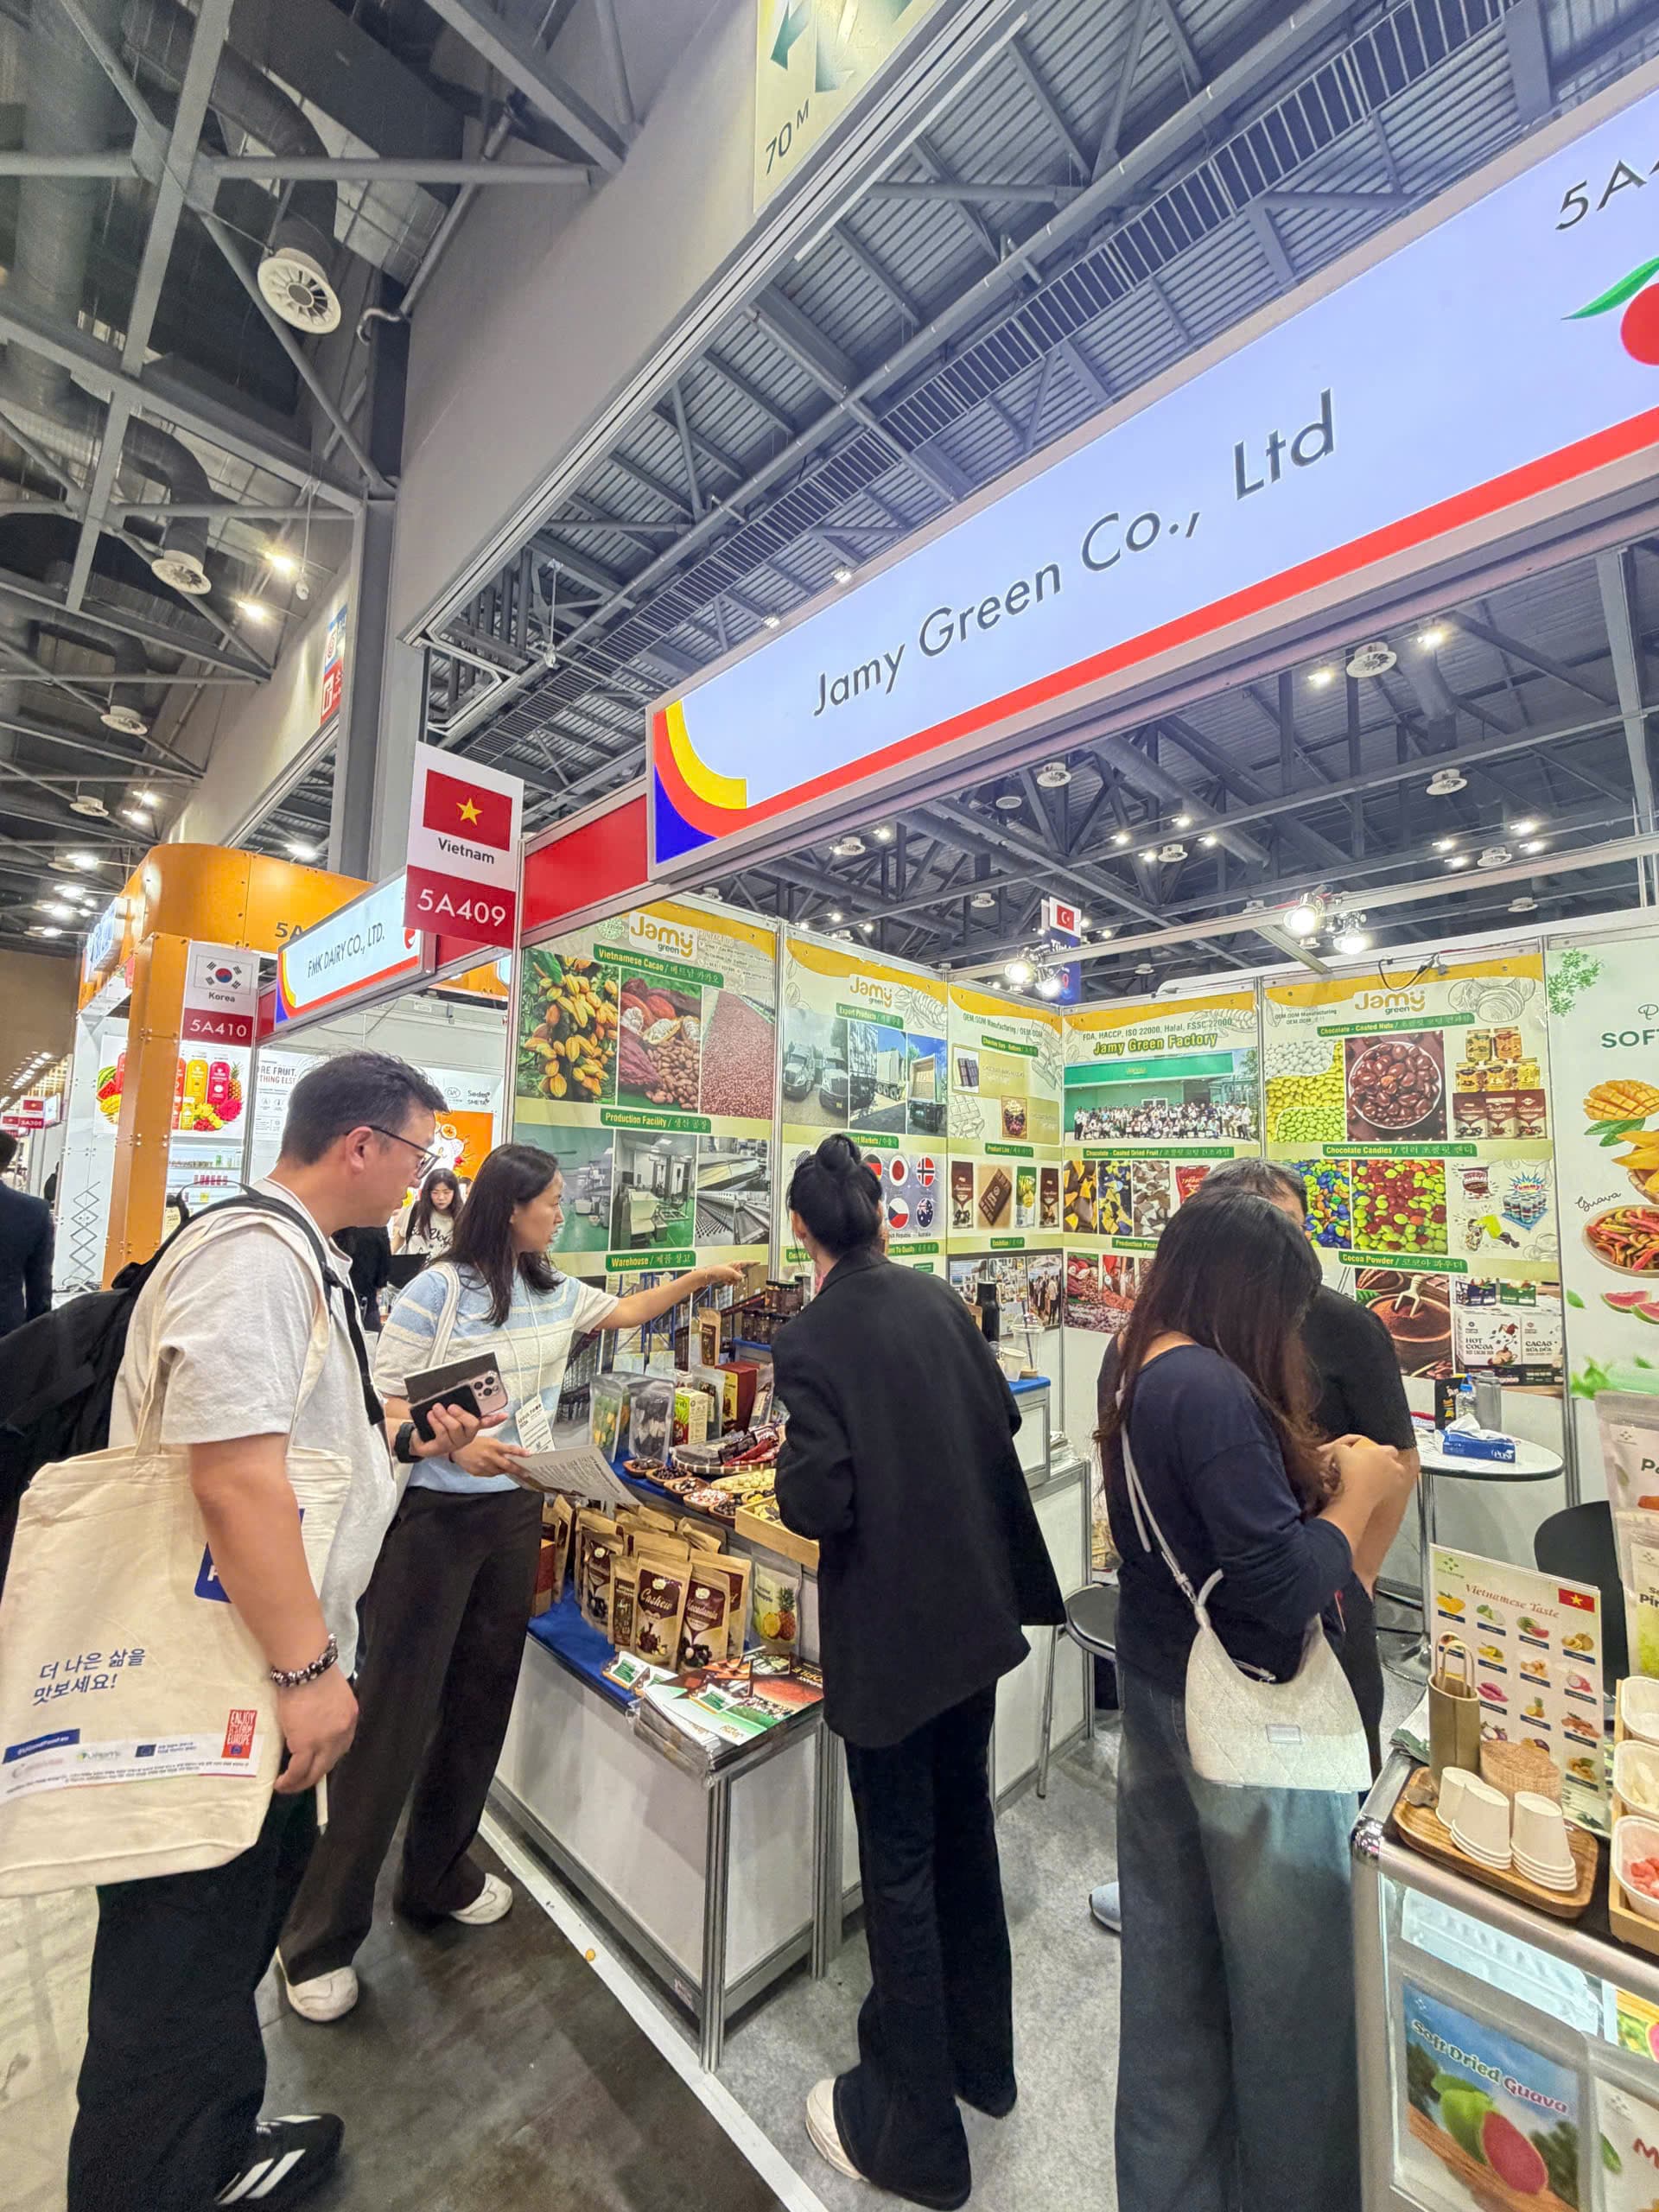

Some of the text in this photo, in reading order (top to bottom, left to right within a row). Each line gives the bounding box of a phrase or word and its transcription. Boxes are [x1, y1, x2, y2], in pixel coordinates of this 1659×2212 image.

[766, 122, 792, 175] 70
[1555, 160, 1659, 231] 5A
[813, 387, 1335, 717] Jamy Green Co., Ltd
[437, 836, 495, 865] Vietnam
[416, 888, 506, 927] 5A409
[324, 941, 346, 970] DAIRY
[367, 923, 385, 948] LTD.
[630, 916, 693, 957] Jamy
[658, 943, 680, 955] green
[599, 949, 642, 967] Vietnamese
[644, 958, 664, 972] Cacao
[208, 991, 236, 1003] Korea
[850, 976, 893, 1008] Jamy
[1354, 990, 1426, 1013] Jamy
[1300, 1008, 1338, 1018] Manufacturing
[1385, 1006, 1410, 1015] green
[189, 1019, 247, 1038] 5A410
[987, 1019, 1016, 1035] Manufacturing
[1125, 1028, 1137, 1038] ISO
[1186, 1021, 1206, 1032] FSSC
[1209, 1017, 1233, 1027] 22000
[1320, 1026, 1350, 1035] Chocolate
[1355, 1023, 1378, 1032] Coated
[1093, 1033, 1217, 1056] Jamy Green Factory
[273, 1066, 297, 1077] FRUIT.
[606, 1112, 641, 1125] Production
[642, 1116, 667, 1128] Facility
[1326, 1146, 1362, 1154] Chocolate
[1363, 1146, 1393, 1154] Candies
[1574, 1191, 1622, 1212] Guava
[612, 1255, 649, 1268] Warehouse
[1342, 1254, 1364, 1262] Cocoa
[1365, 1255, 1395, 1265] Powder
[640, 1588, 673, 1611] Cashew
[1465, 1583, 1560, 1618] Vietnamese Taste
[39, 1647, 147, 1680] 더 나은 삶을
[32, 1673, 118, 1707] 맛보세요!
[232, 1711, 255, 1724] ENJOY
[227, 1734, 251, 1745] EUROPE
[1411, 2018, 1569, 2113] Soft Dried Guava
